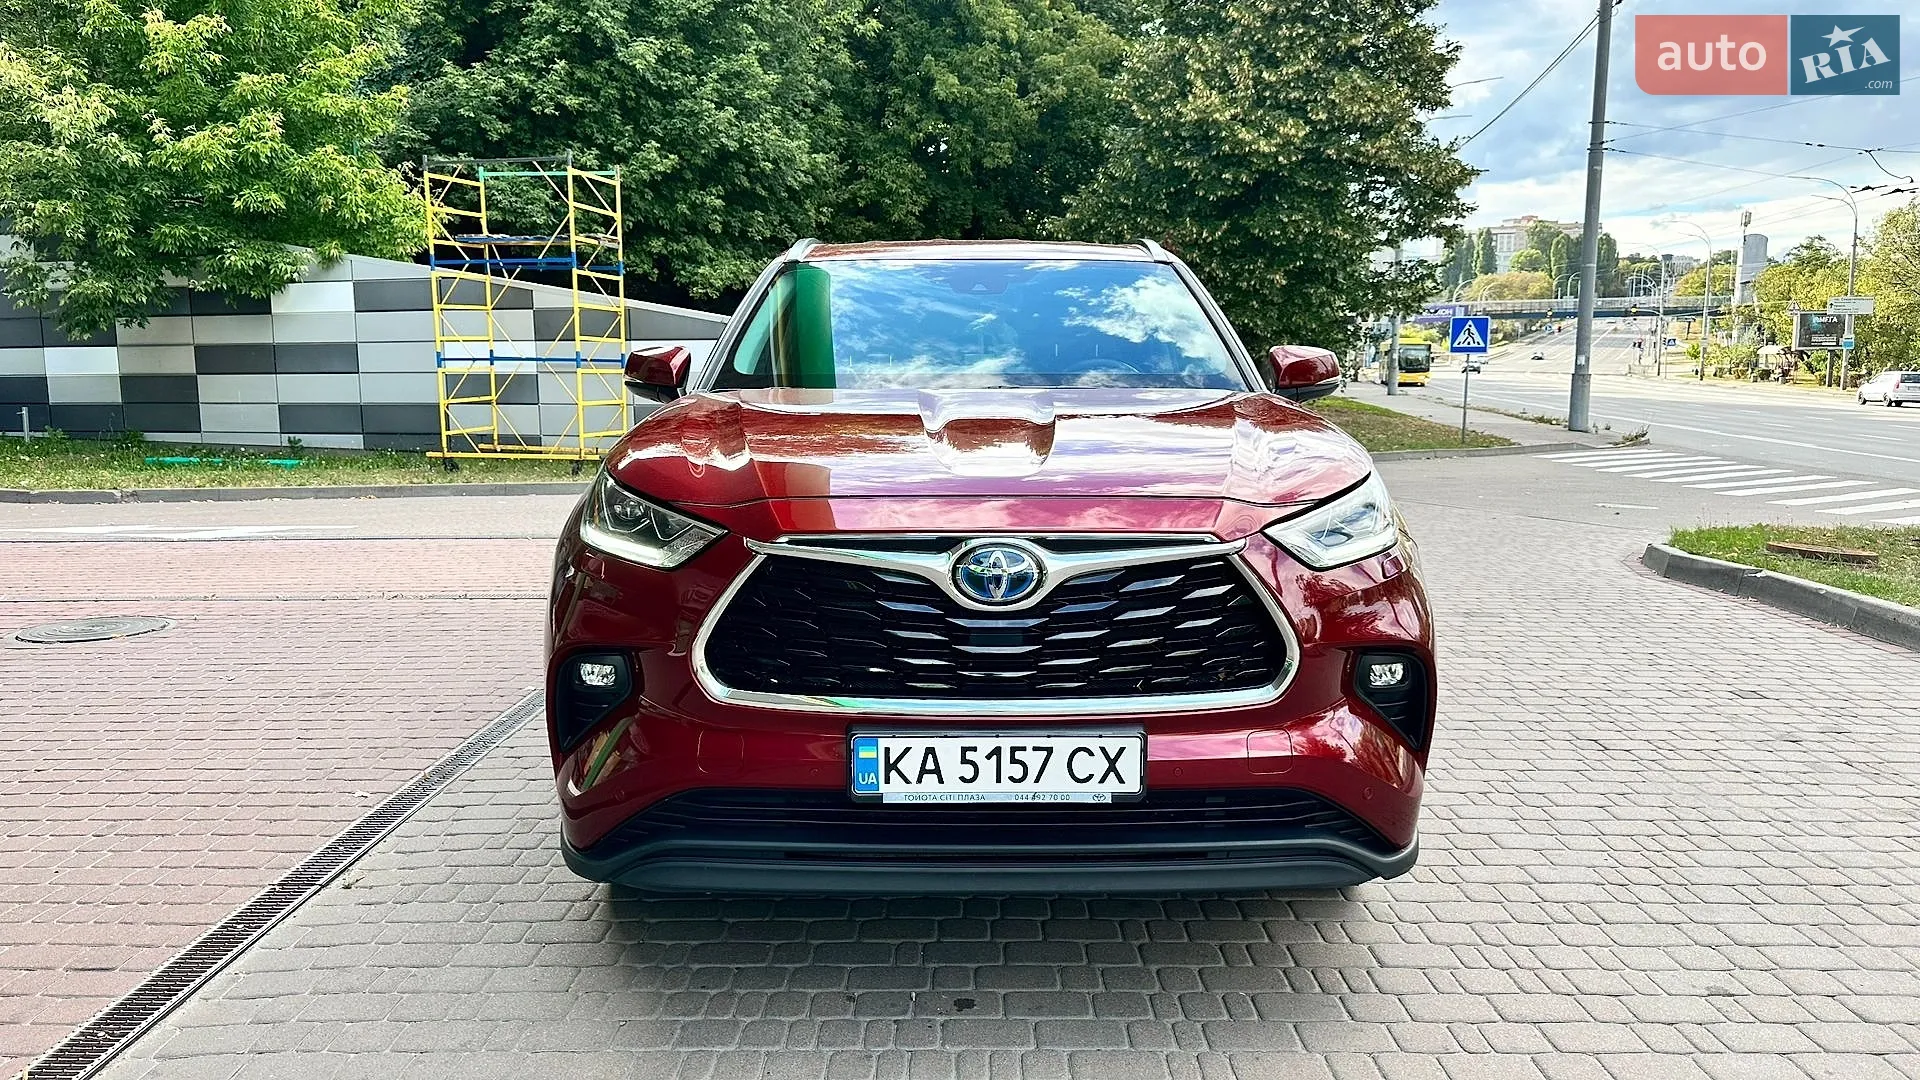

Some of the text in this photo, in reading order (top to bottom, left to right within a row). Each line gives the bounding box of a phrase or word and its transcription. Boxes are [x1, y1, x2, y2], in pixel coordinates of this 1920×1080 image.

[884, 746, 1127, 784] KA 5157 CX
[859, 772, 877, 785] UA
[1014, 793, 1029, 801] 044
[1049, 793, 1058, 801] 70
[1060, 793, 1070, 801] 00
